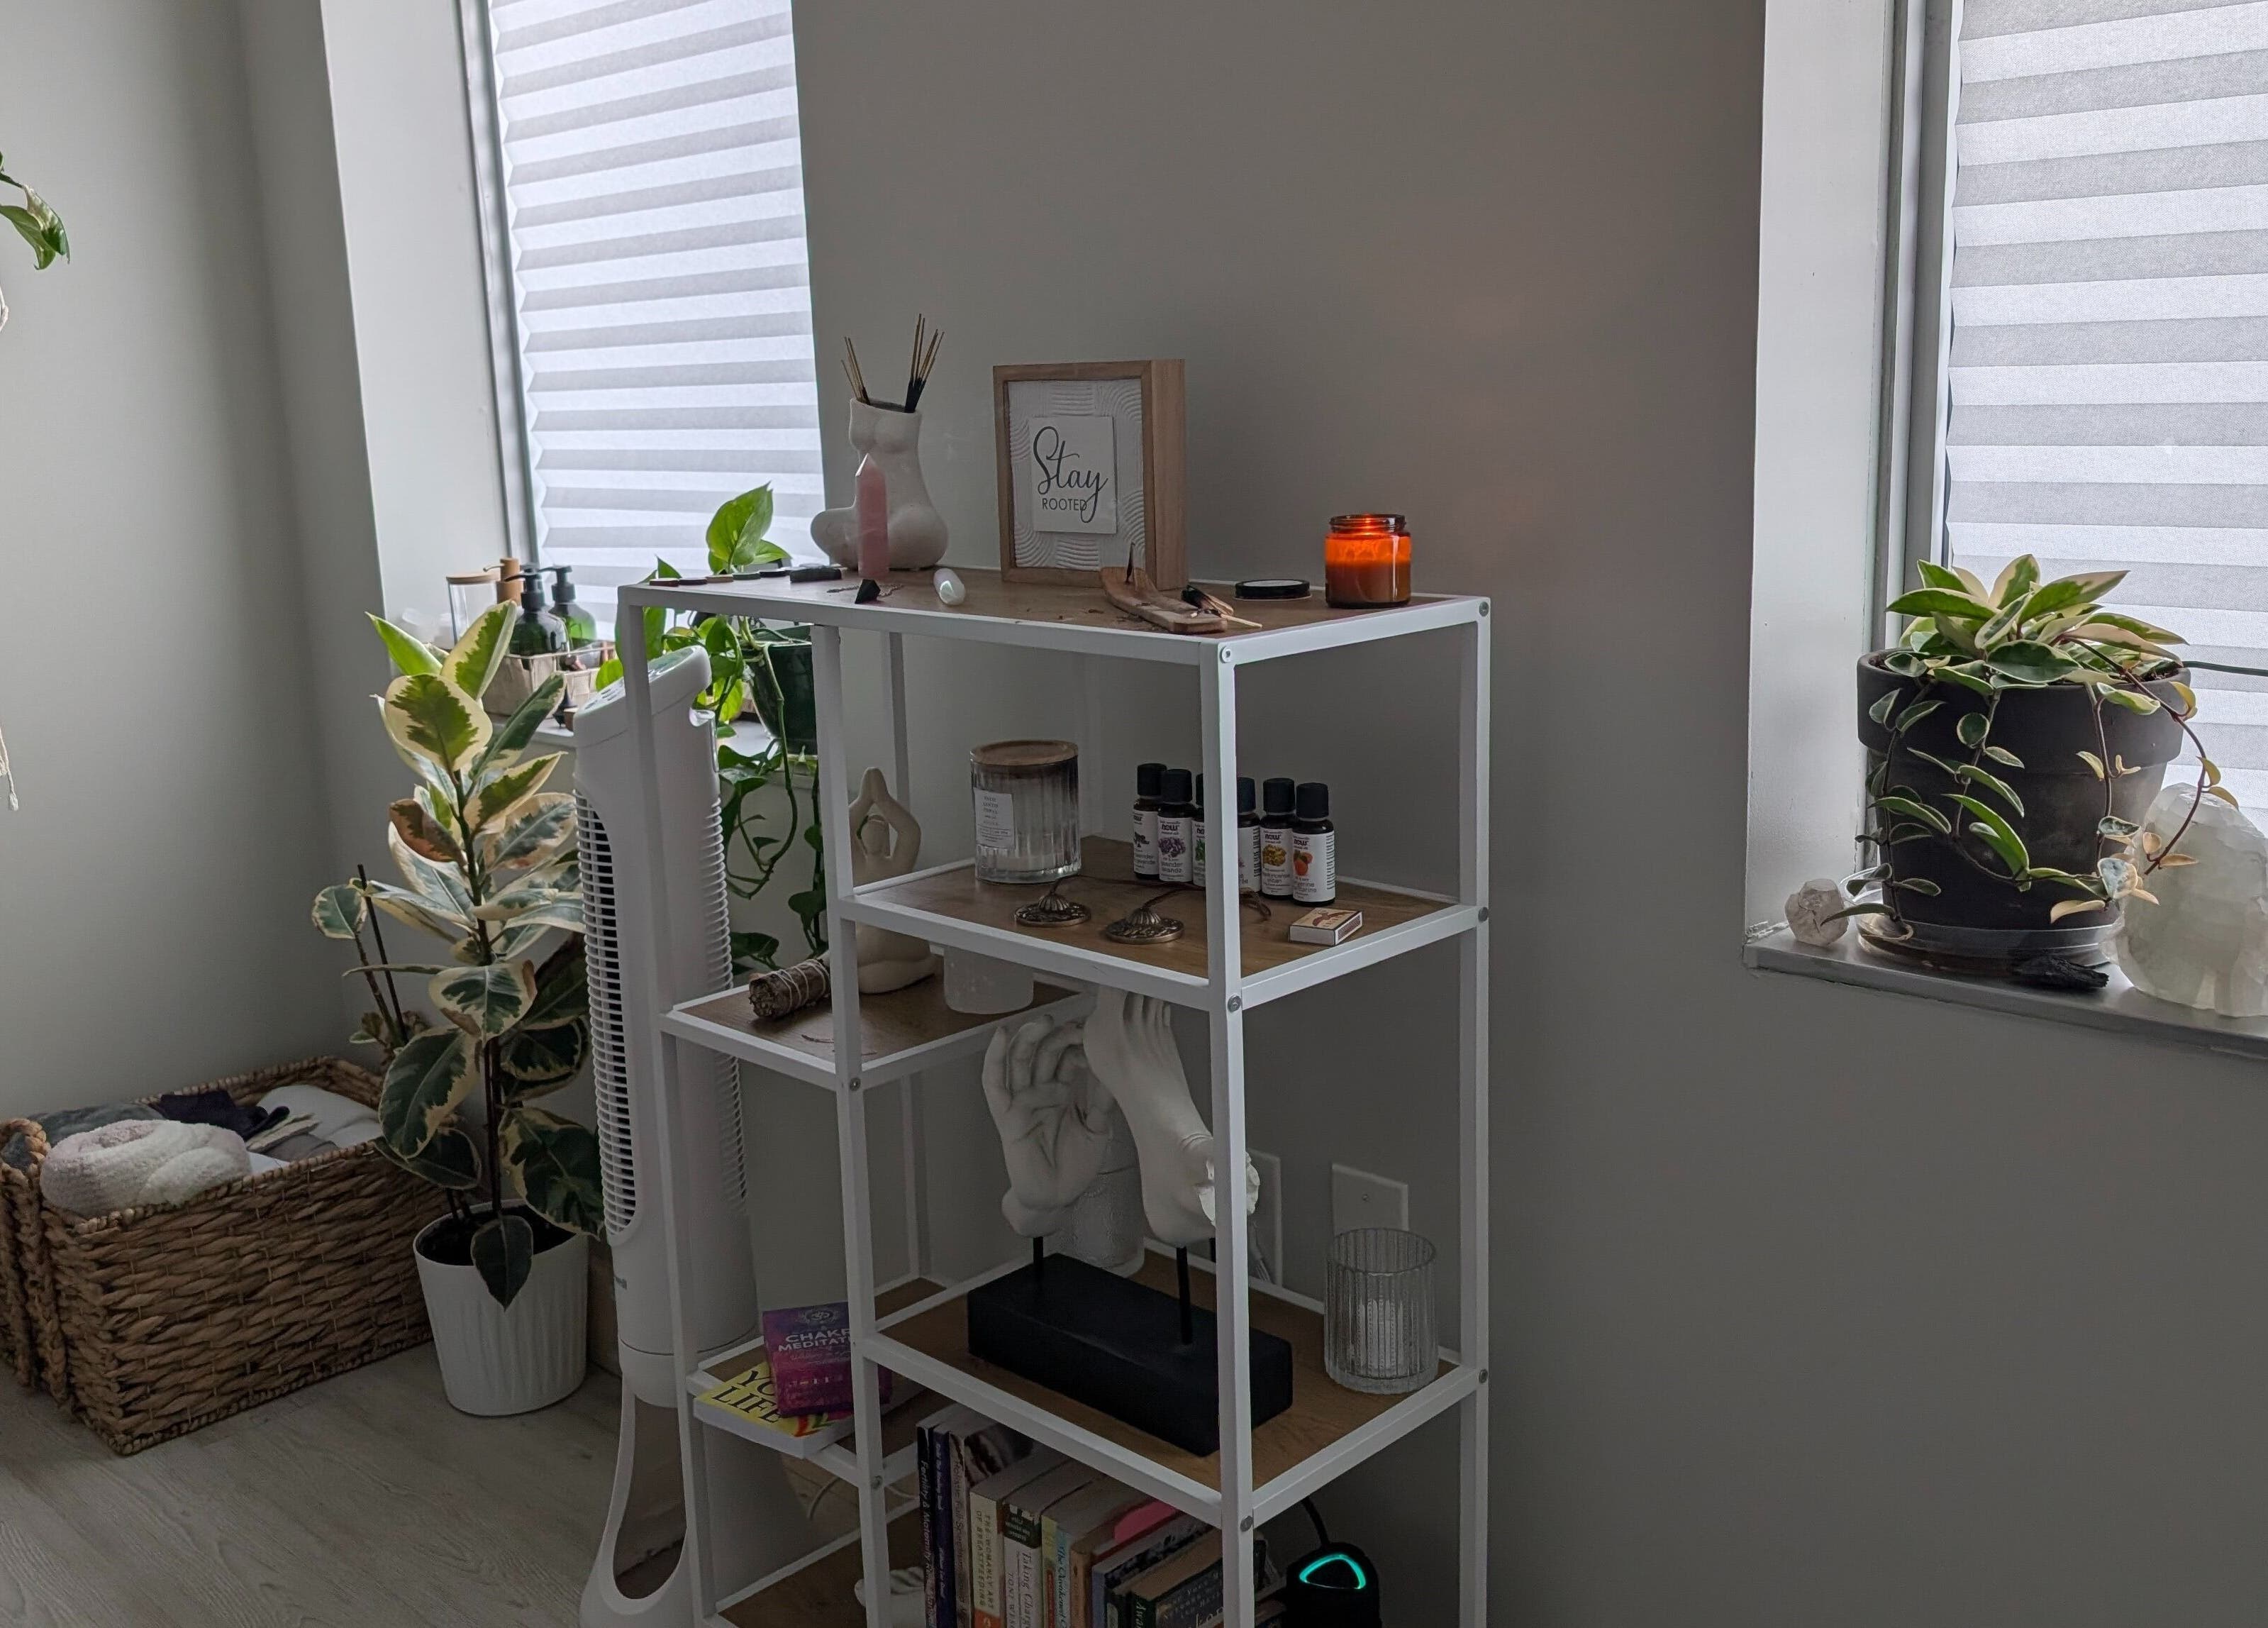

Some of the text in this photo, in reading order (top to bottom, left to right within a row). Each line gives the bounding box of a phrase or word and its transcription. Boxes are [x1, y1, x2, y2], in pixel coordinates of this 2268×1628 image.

[1033, 426, 1108, 523] Stay
[1043, 498, 1087, 511] ROOTED
[778, 1336, 851, 1352] MEDITAT
[785, 1328, 850, 1343] CHAKR
[738, 1370, 775, 1396] YO
[712, 1385, 782, 1424] LIFE
[1021, 1553, 1033, 1590] Taking
